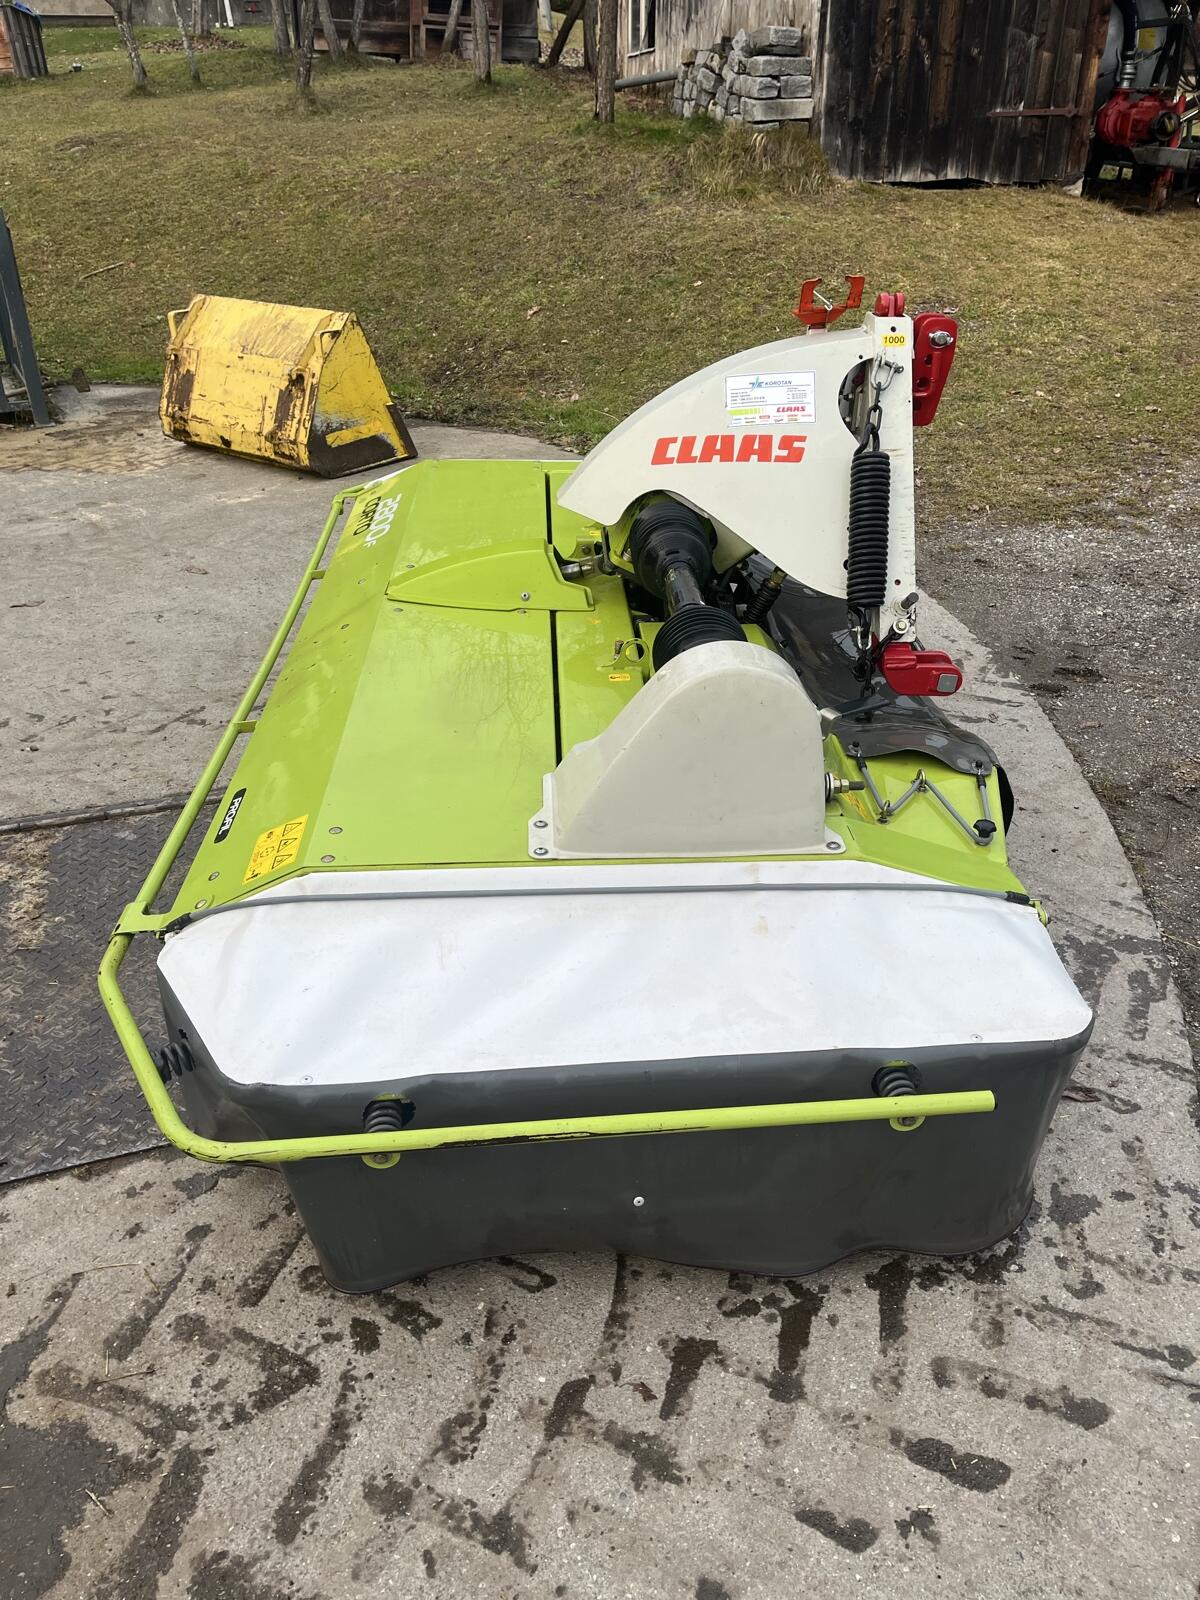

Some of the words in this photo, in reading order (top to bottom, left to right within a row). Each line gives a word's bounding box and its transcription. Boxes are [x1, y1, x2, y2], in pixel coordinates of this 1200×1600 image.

[883, 335, 905, 344] 1000
[651, 434, 808, 466] CLAAS
[353, 496, 382, 536] CORTO
[218, 796, 243, 836] PROFIL
